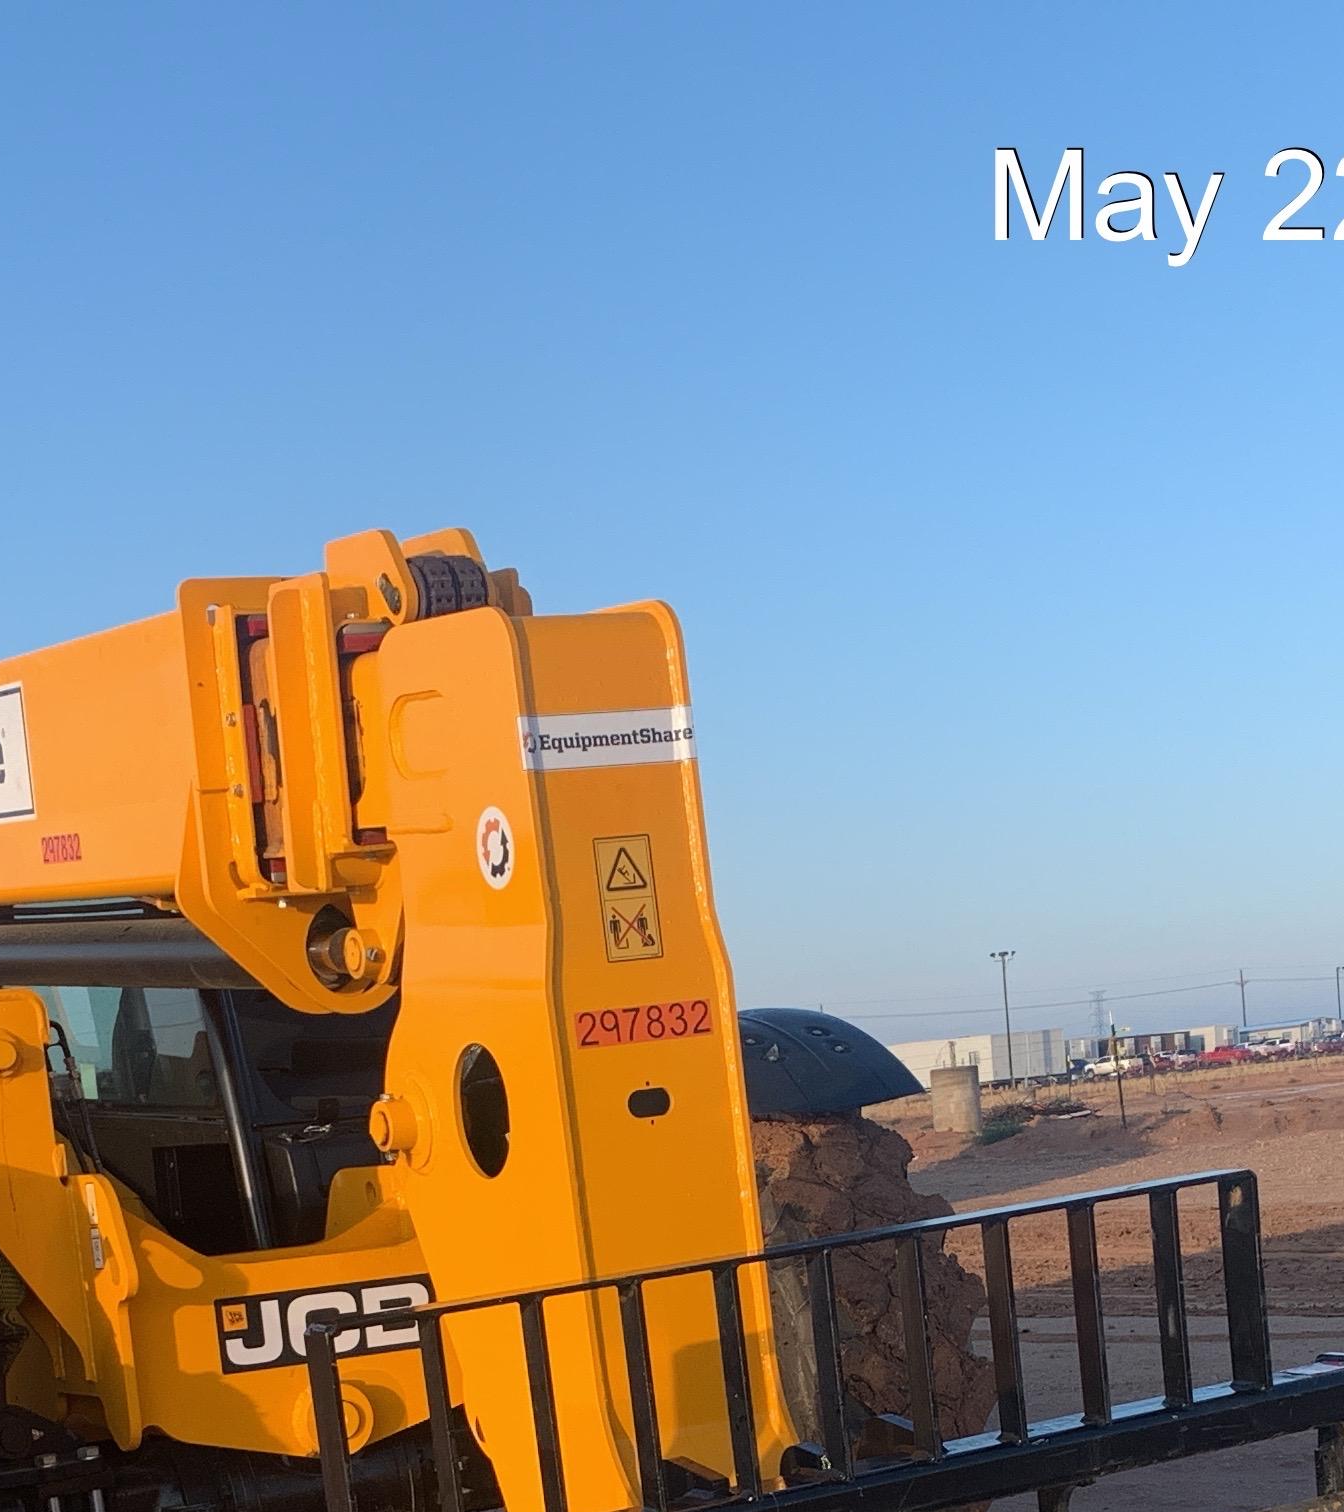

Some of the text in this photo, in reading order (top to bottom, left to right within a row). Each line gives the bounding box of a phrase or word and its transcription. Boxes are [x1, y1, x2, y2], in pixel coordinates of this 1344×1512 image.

[538, 726, 694, 754] EquipmentShare
[41, 833, 83, 864] 297832
[578, 1000, 712, 1047] 297832
